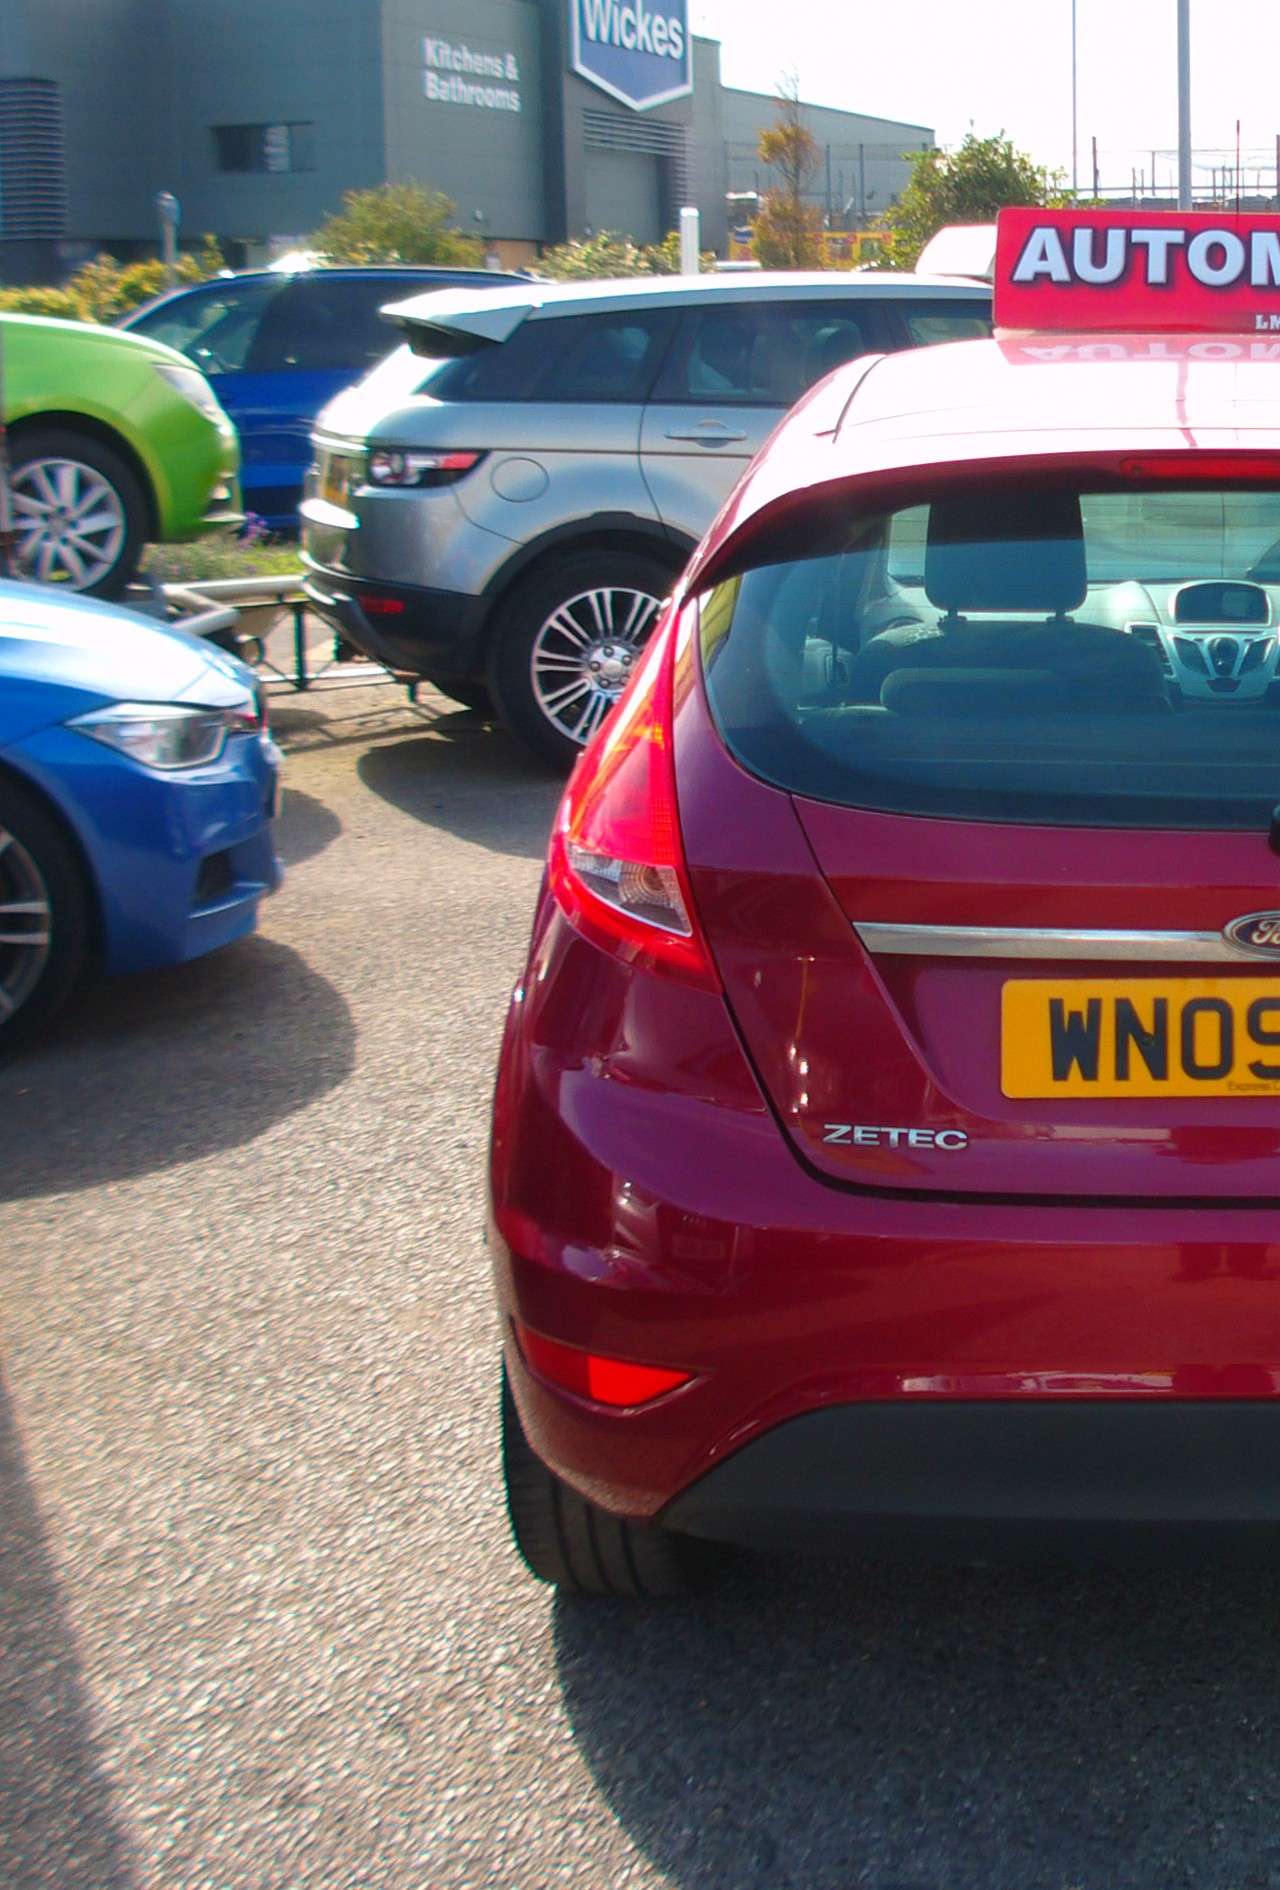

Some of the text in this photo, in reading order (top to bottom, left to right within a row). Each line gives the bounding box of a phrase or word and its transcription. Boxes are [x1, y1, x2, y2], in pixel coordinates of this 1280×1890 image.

[584, 0, 684, 60] Wickes
[423, 37, 519, 81] Kitchens &
[424, 70, 521, 112] Bathrooms
[822, 1123, 969, 1151] ZETEC
